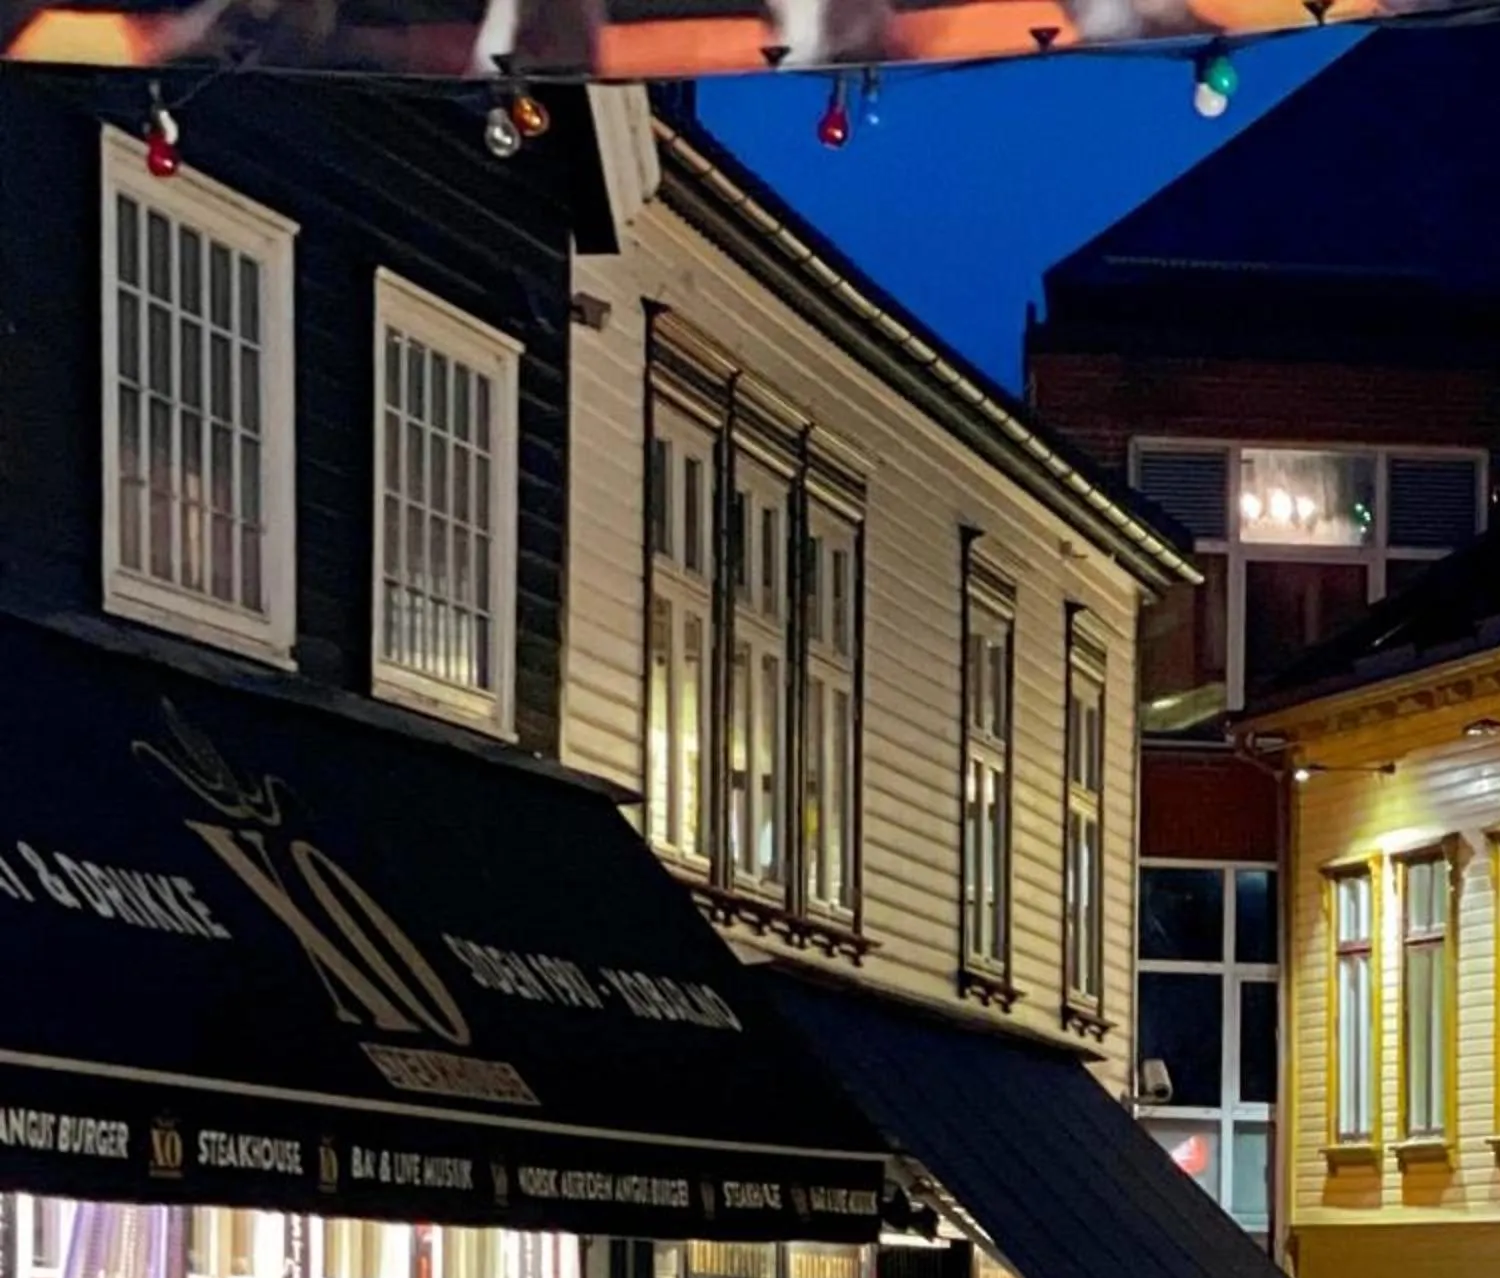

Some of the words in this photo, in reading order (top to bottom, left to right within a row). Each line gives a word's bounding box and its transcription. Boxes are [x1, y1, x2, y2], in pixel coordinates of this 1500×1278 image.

[53, 850, 232, 941] DRIKKE
[57, 1114, 129, 1160] BURGER
[198, 1129, 304, 1176] STEAKHOUSE
